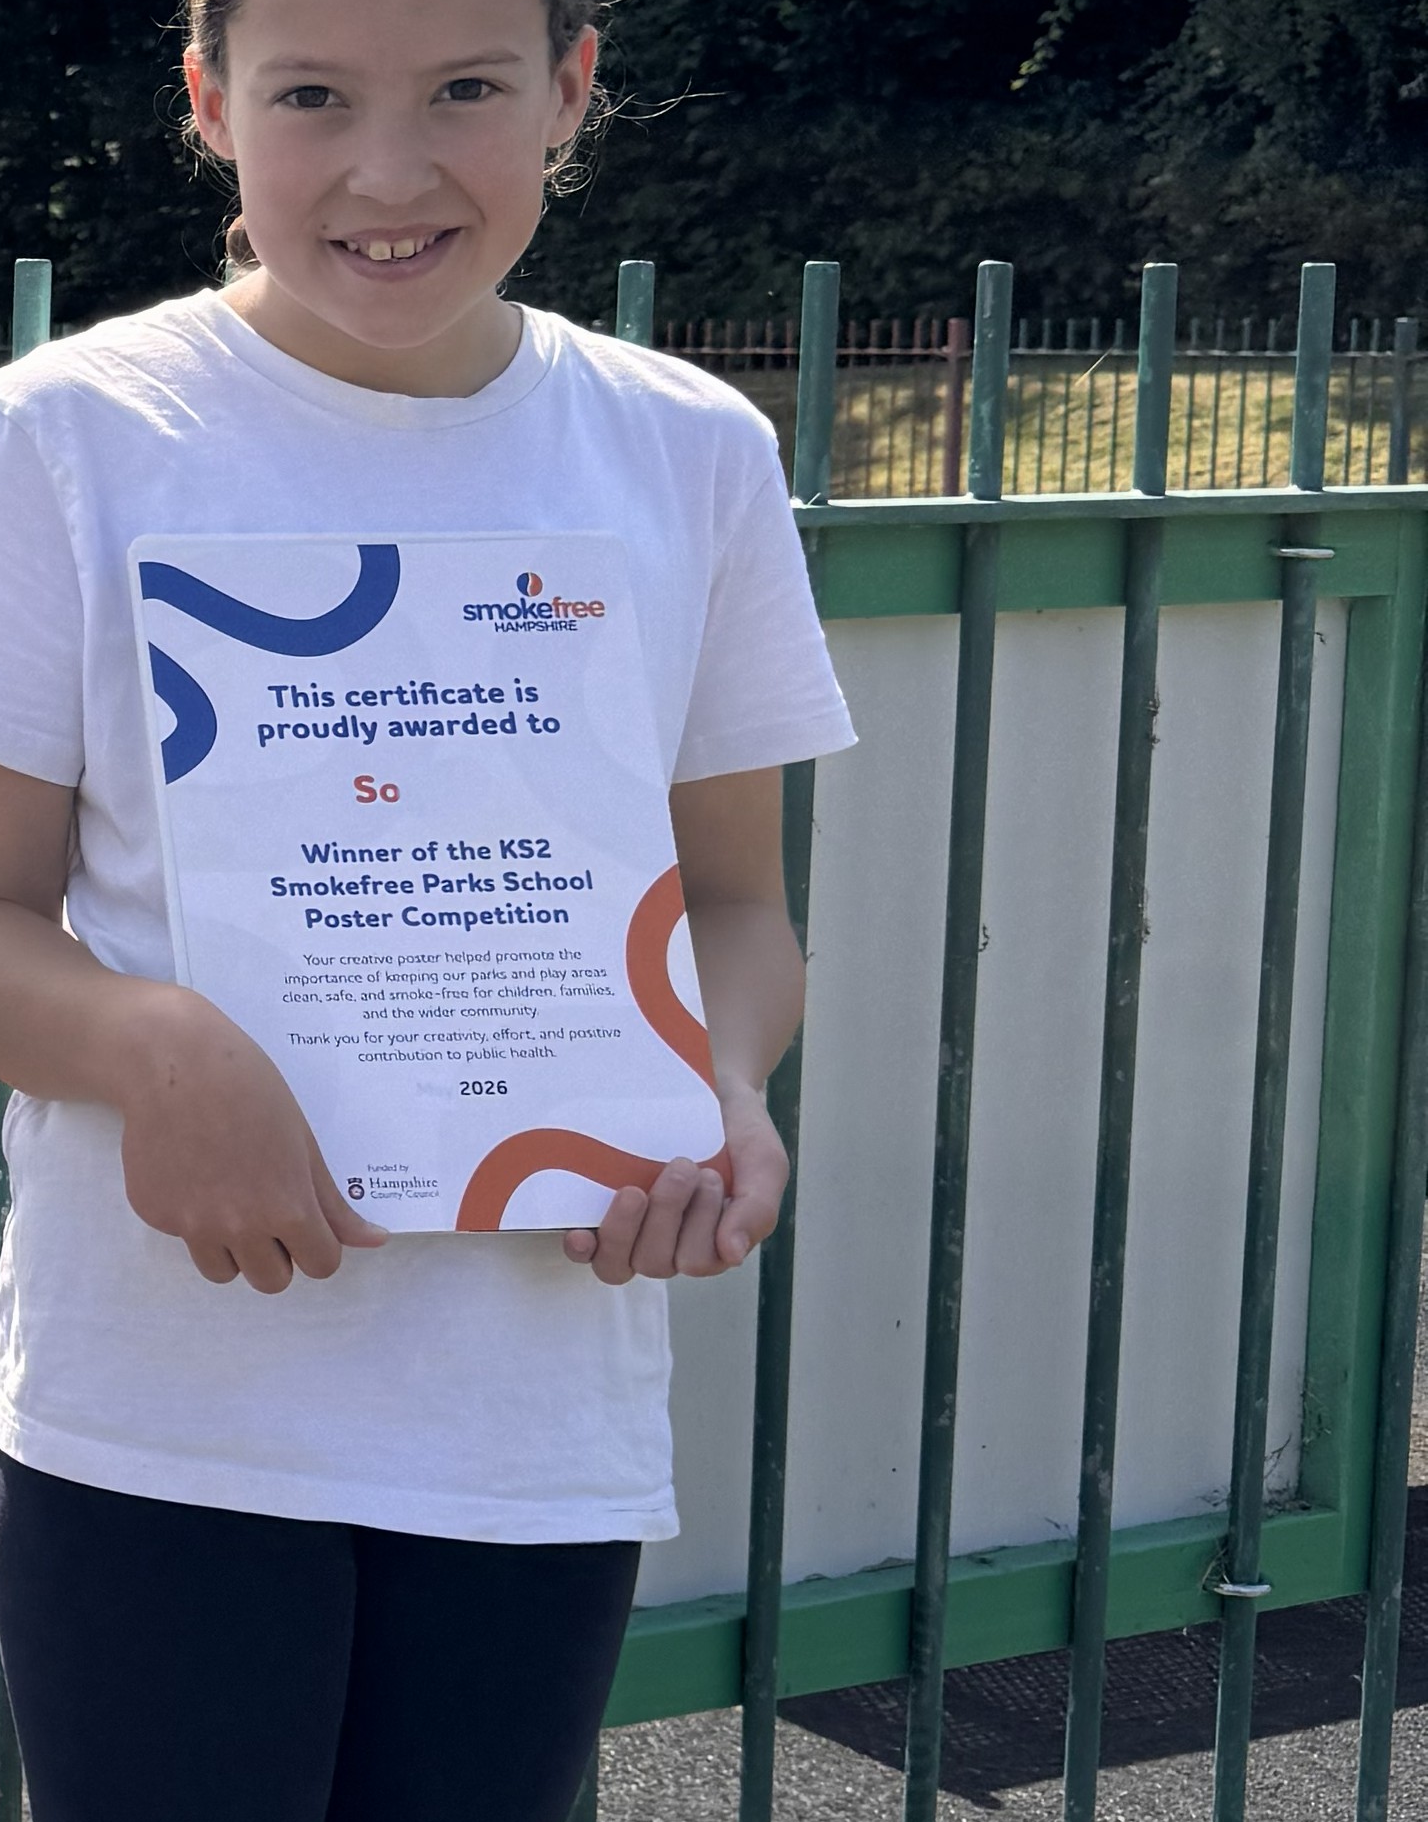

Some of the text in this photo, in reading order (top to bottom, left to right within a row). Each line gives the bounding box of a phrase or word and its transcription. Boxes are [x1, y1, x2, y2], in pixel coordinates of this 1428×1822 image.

[463, 598, 605, 623] smokefree
[495, 620, 578, 633] HAMPSHIRE
[267, 678, 539, 708] This certificate is
[258, 714, 560, 747] proudly awarded to
[354, 775, 400, 803] So
[301, 838, 551, 864] Winner of the KS2
[270, 869, 593, 897] Smokefree Parks School
[305, 903, 569, 933] Poster Competition
[304, 949, 581, 966] Your creative poster helped promote the
[284, 967, 607, 986] importance of keeping our parks and play areas
[282, 984, 615, 1003] clean, safe, and smoke-free for children, families,
[363, 1008, 388, 1019] and
[392, 1006, 414, 1018] the
[419, 1006, 456, 1017] wider
[288, 1028, 620, 1046] Thank you for your creativity, effort, and positive
[358, 1048, 443, 1062] contribution
[447, 1049, 461, 1060] to
[466, 1047, 507, 1062] public
[459, 1081, 507, 1095] 2026
[370, 1176, 438, 1191] Hampshire
